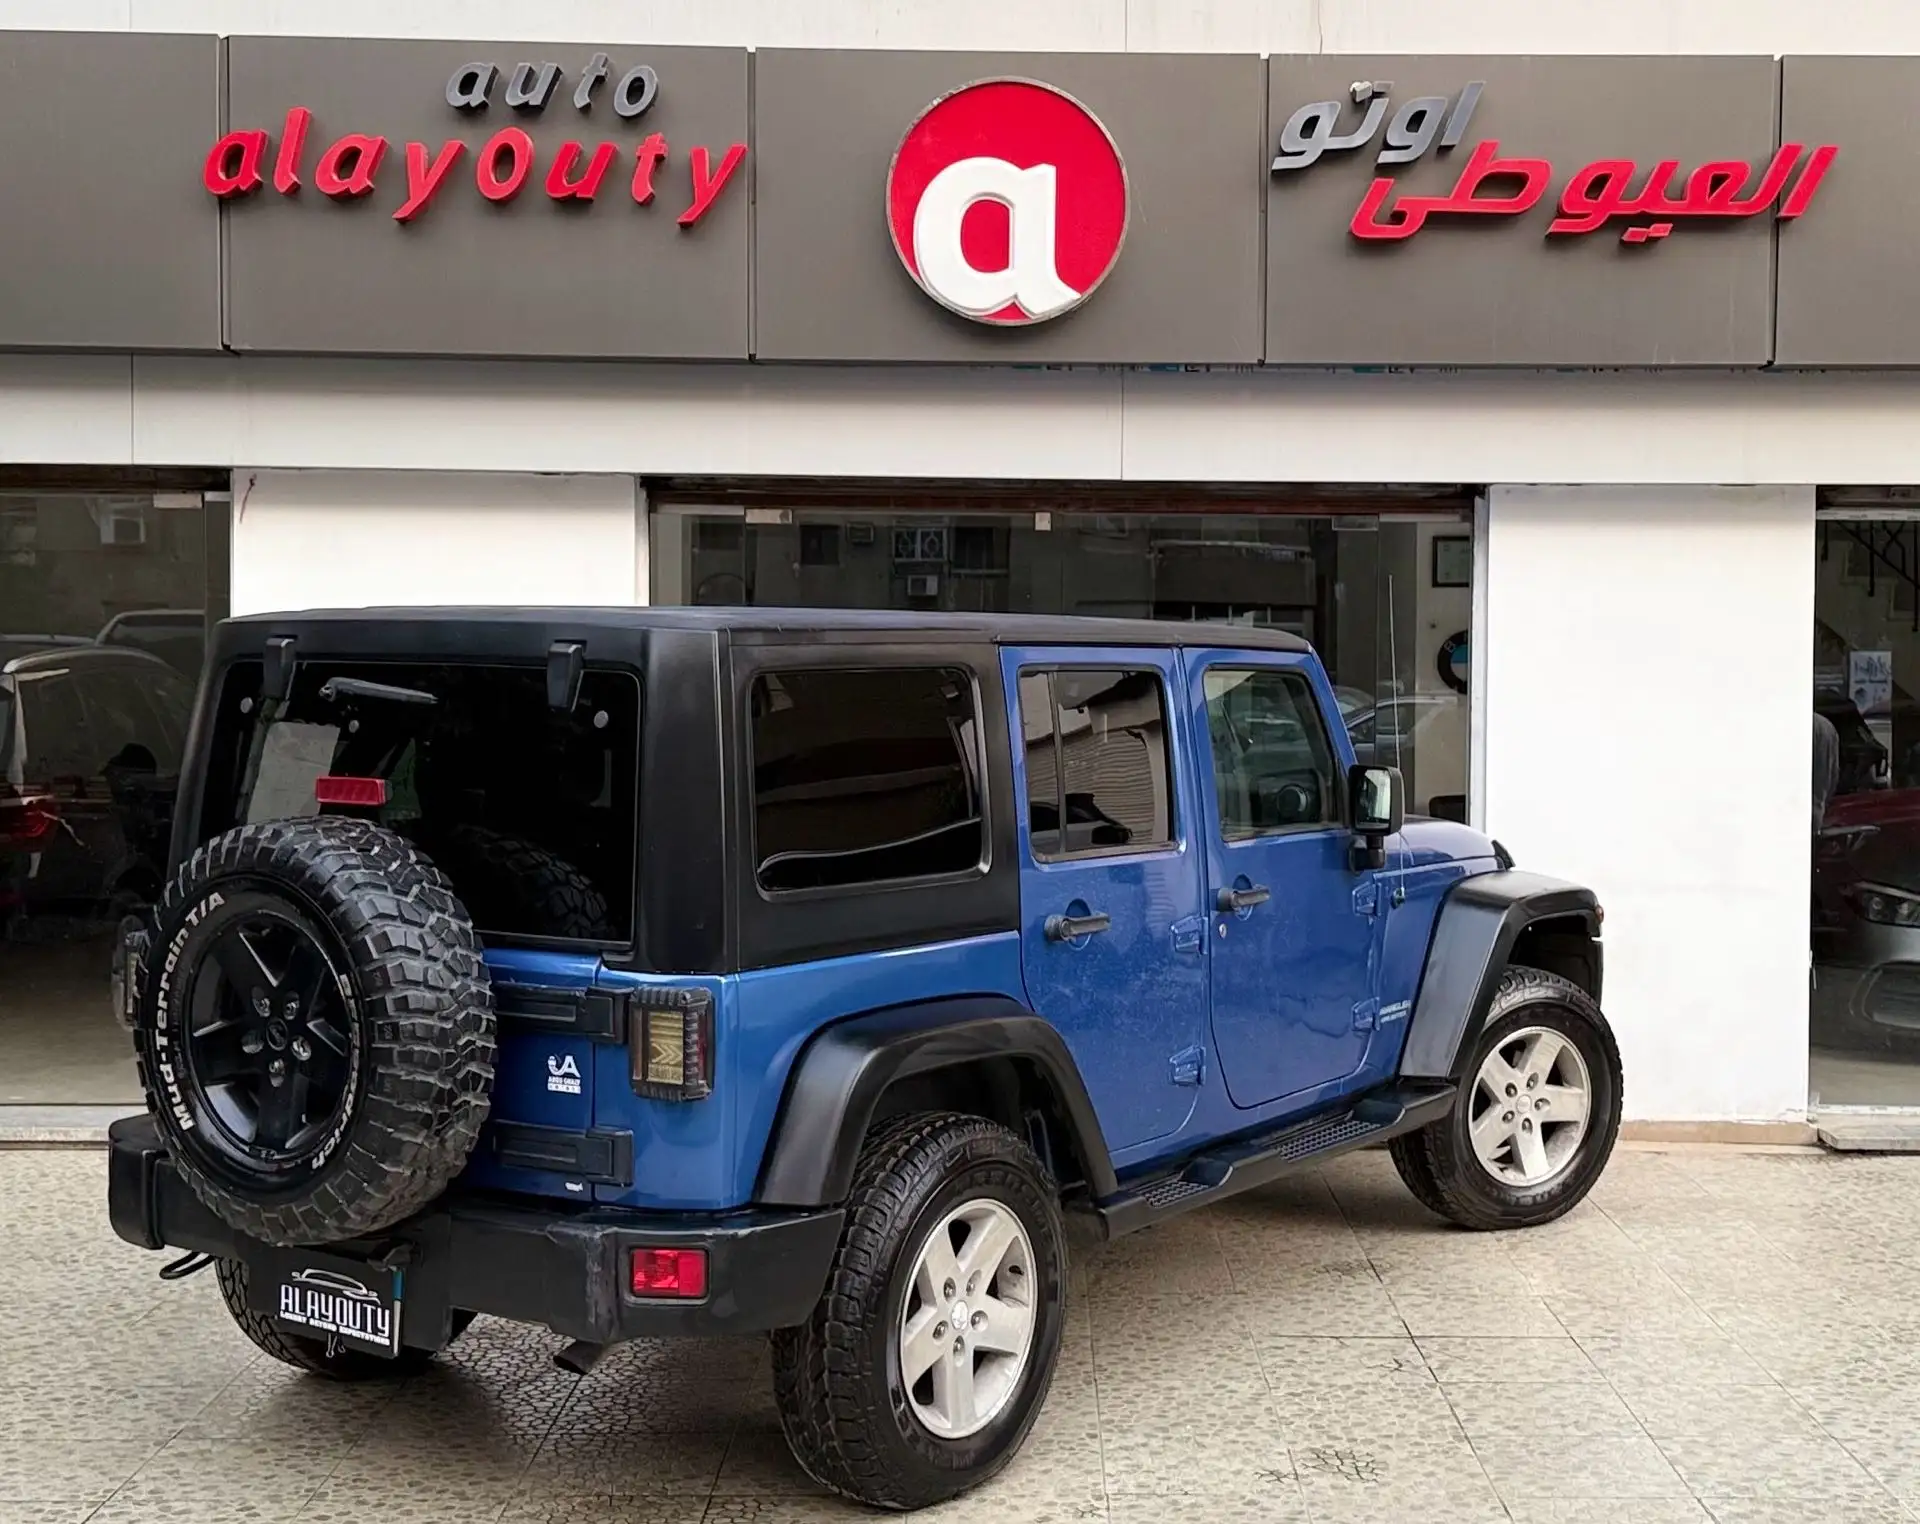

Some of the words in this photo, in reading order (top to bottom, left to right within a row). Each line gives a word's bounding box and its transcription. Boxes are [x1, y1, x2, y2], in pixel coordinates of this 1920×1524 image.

[446, 53, 660, 118] auto
[203, 106, 748, 228] alayouty
[913, 156, 1081, 319] a
[280, 1284, 390, 1338] ALAYOUTY
